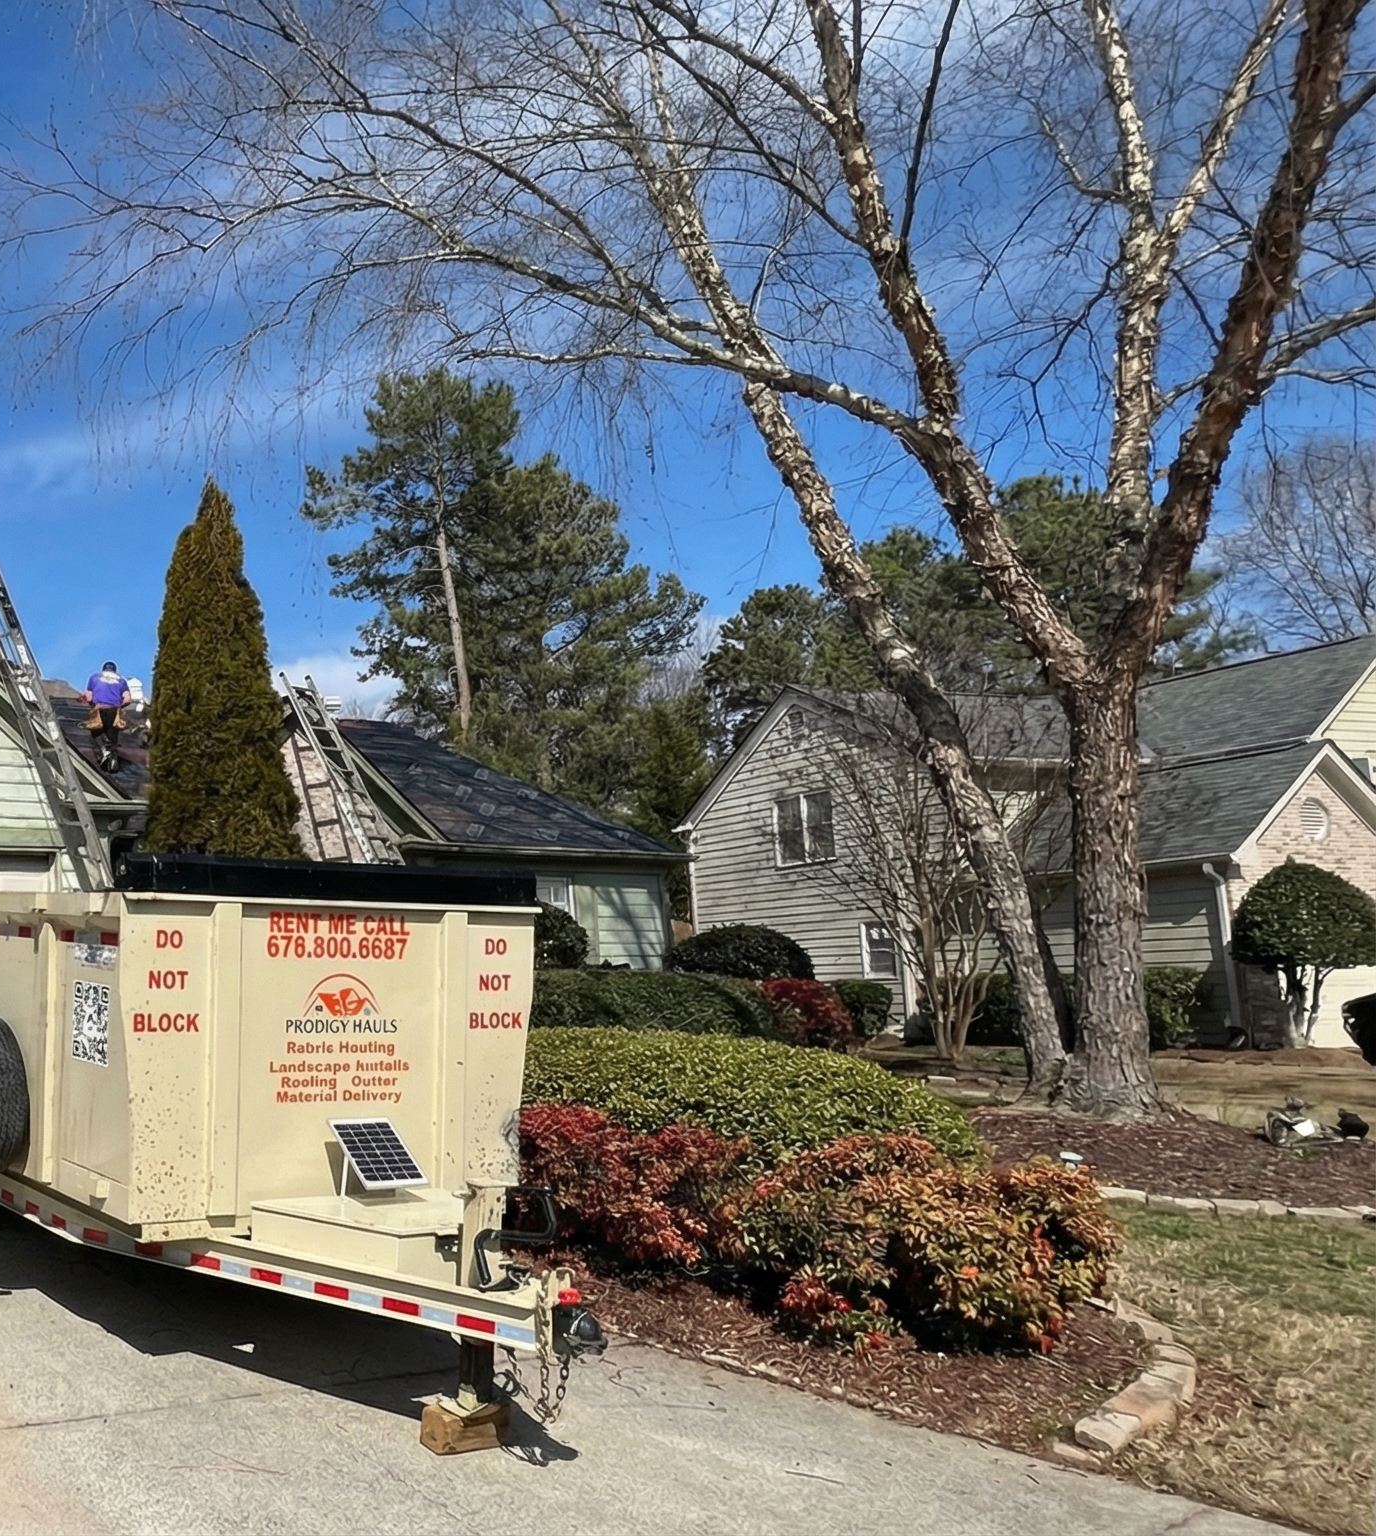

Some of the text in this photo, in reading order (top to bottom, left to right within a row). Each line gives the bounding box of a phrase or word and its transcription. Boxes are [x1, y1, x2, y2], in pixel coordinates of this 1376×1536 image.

[269, 911, 410, 936] RENT ME CALL
[156, 929, 183, 949] DO
[485, 938, 507, 955] DO
[148, 970, 189, 990] NOT
[479, 974, 511, 991] NOT
[133, 1013, 200, 1033] BLOCK
[285, 1019, 398, 1034] PRODIGY HAULS
[469, 1012, 522, 1029] BLOCK
[269, 1060, 351, 1075] Landscape
[276, 1089, 402, 1104] Material Delivery
